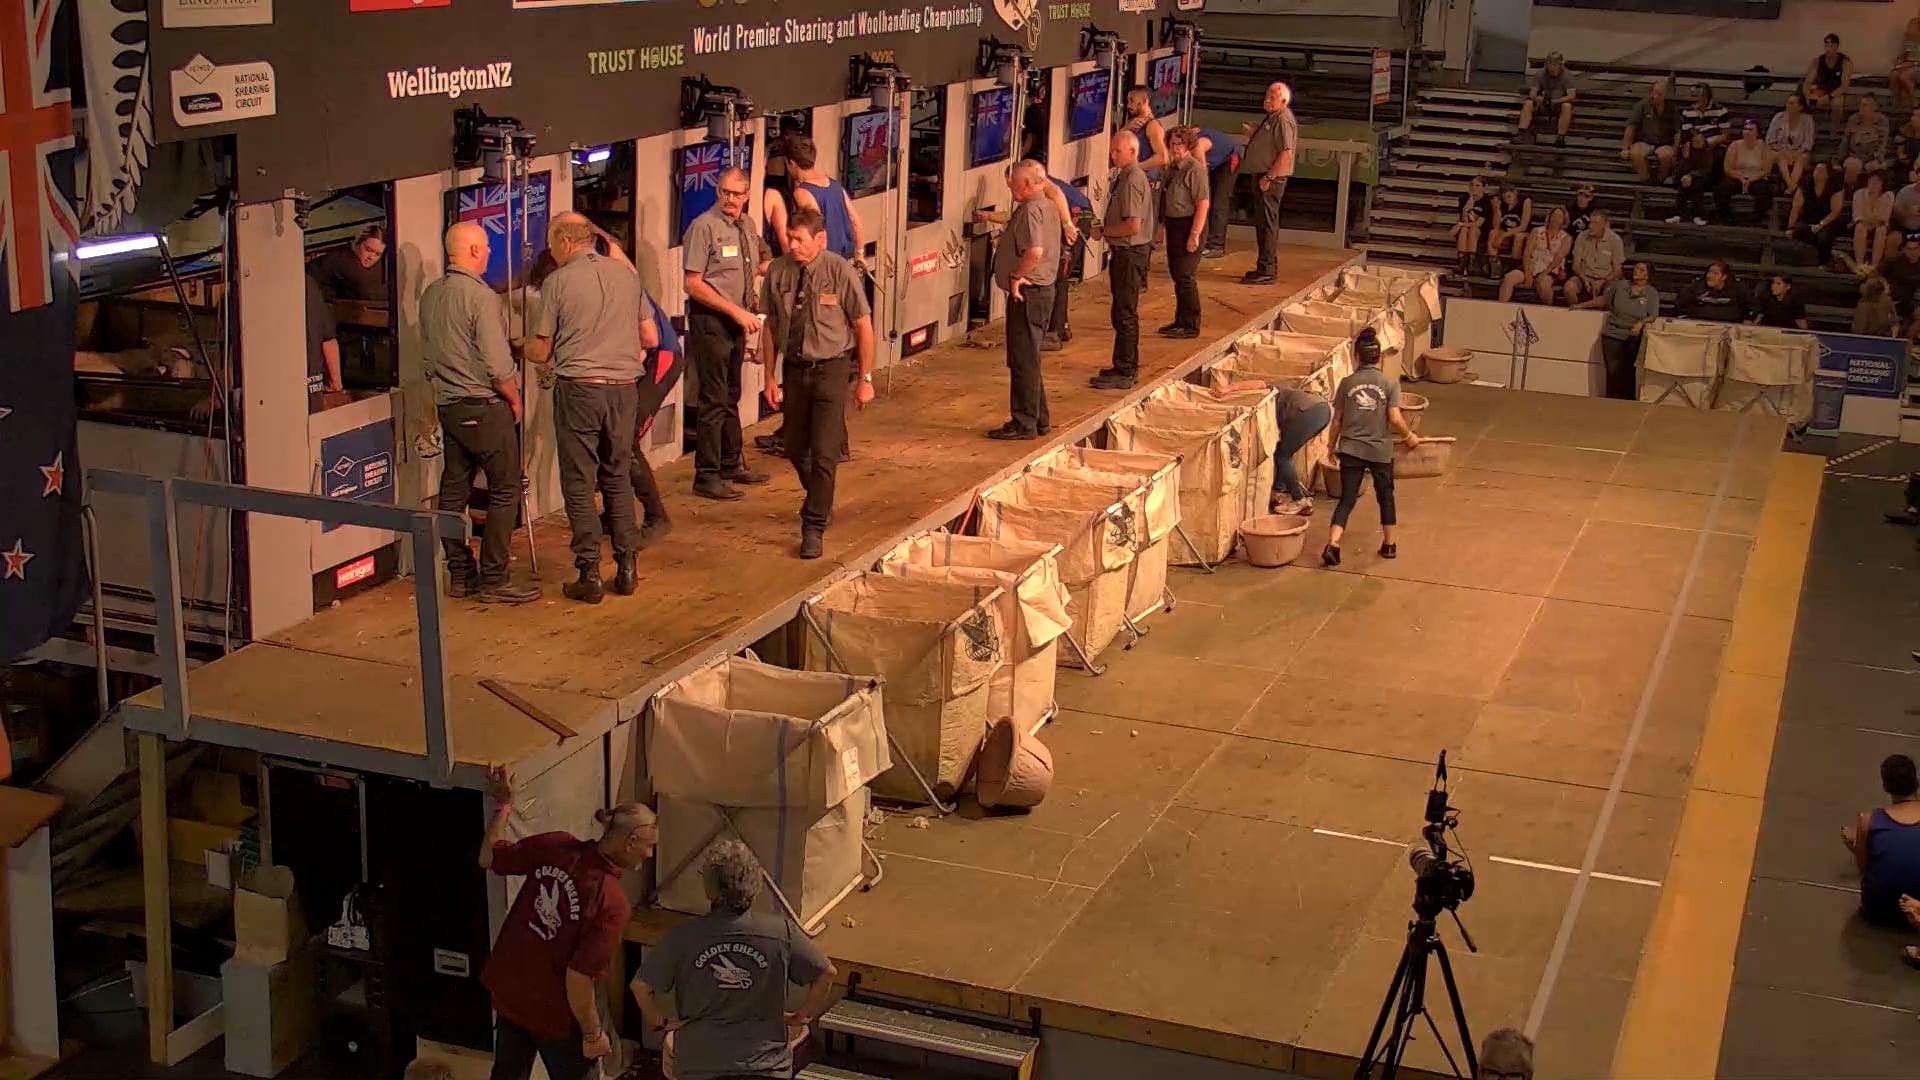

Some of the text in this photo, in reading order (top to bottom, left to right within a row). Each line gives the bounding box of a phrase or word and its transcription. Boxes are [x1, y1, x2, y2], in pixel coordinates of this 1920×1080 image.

[693, 4, 983, 54] World Premier Shearing and Woolhandling Championship
[588, 44, 684, 74] TRUST HOUSE
[234, 72, 270, 84] NATIONAL
[387, 62, 512, 98] WellingtonNZ
[234, 84, 270, 97] SHEARING
[235, 96, 262, 109] CIRCUIT
[1849, 359, 1890, 369] NATIONAL
[1848, 367, 1890, 377] SHEARING
[1847, 375, 1880, 384] CIRCUIT
[535, 865, 581, 921] GOLDEN SHEARS
[695, 943, 768, 969] GOLDEN SHEARS
